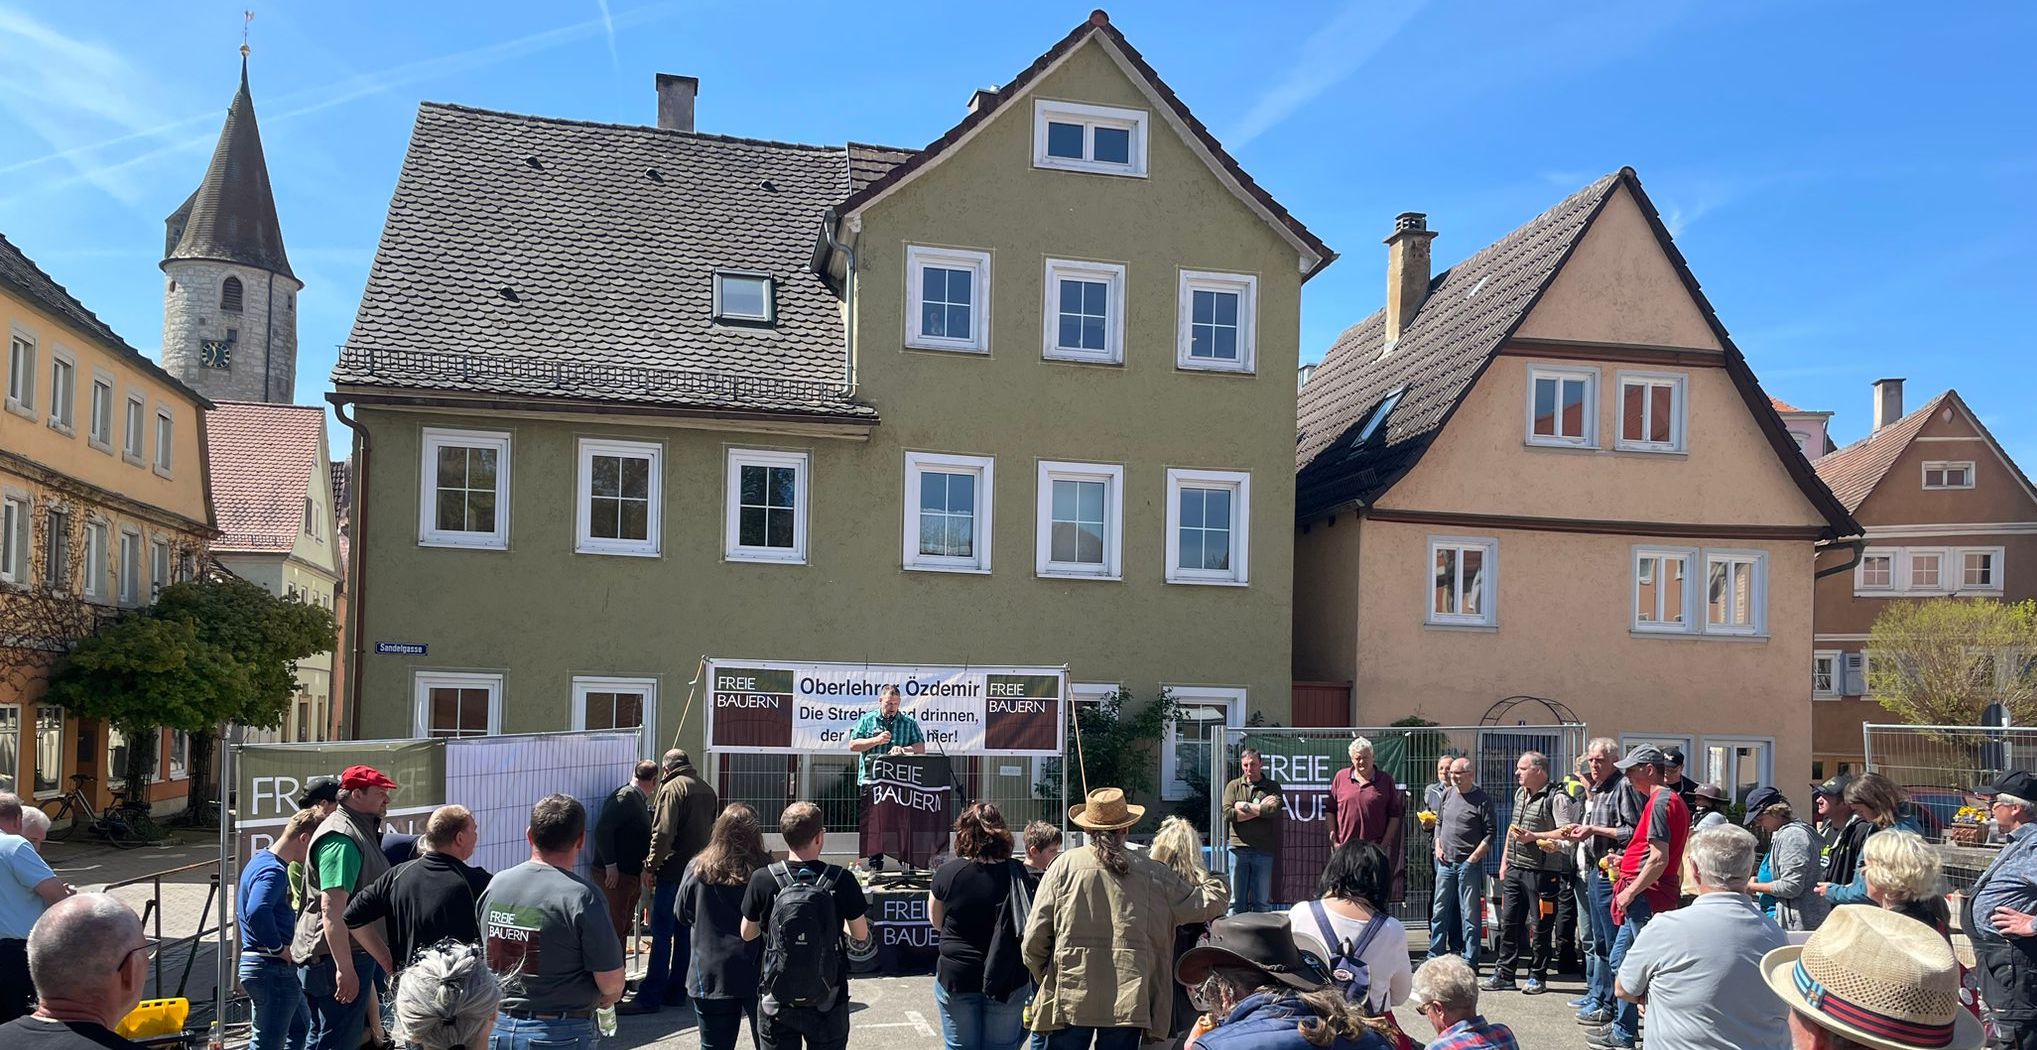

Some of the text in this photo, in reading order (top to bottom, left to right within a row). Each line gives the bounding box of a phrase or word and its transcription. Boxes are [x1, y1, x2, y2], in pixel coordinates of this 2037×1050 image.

[380, 643, 423, 654] Sandelgasse
[718, 676, 756, 690] FREIE
[800, 675, 981, 697] Oberlehr Özdemir
[989, 682, 1025, 696] FREIE
[717, 694, 779, 709] BAUERN
[989, 700, 1045, 713] BAUERN
[800, 706, 824, 720] Die
[920, 708, 979, 725] drinnen,
[820, 729, 845, 742] der
[926, 730, 958, 743] hier!
[873, 760, 923, 785] FREIE
[873, 785, 942, 813] BAUERN
[489, 910, 516, 925] FREIE
[884, 900, 929, 920] FREI
[488, 926, 529, 942] BAUERN
[884, 927, 940, 947] BAUE
